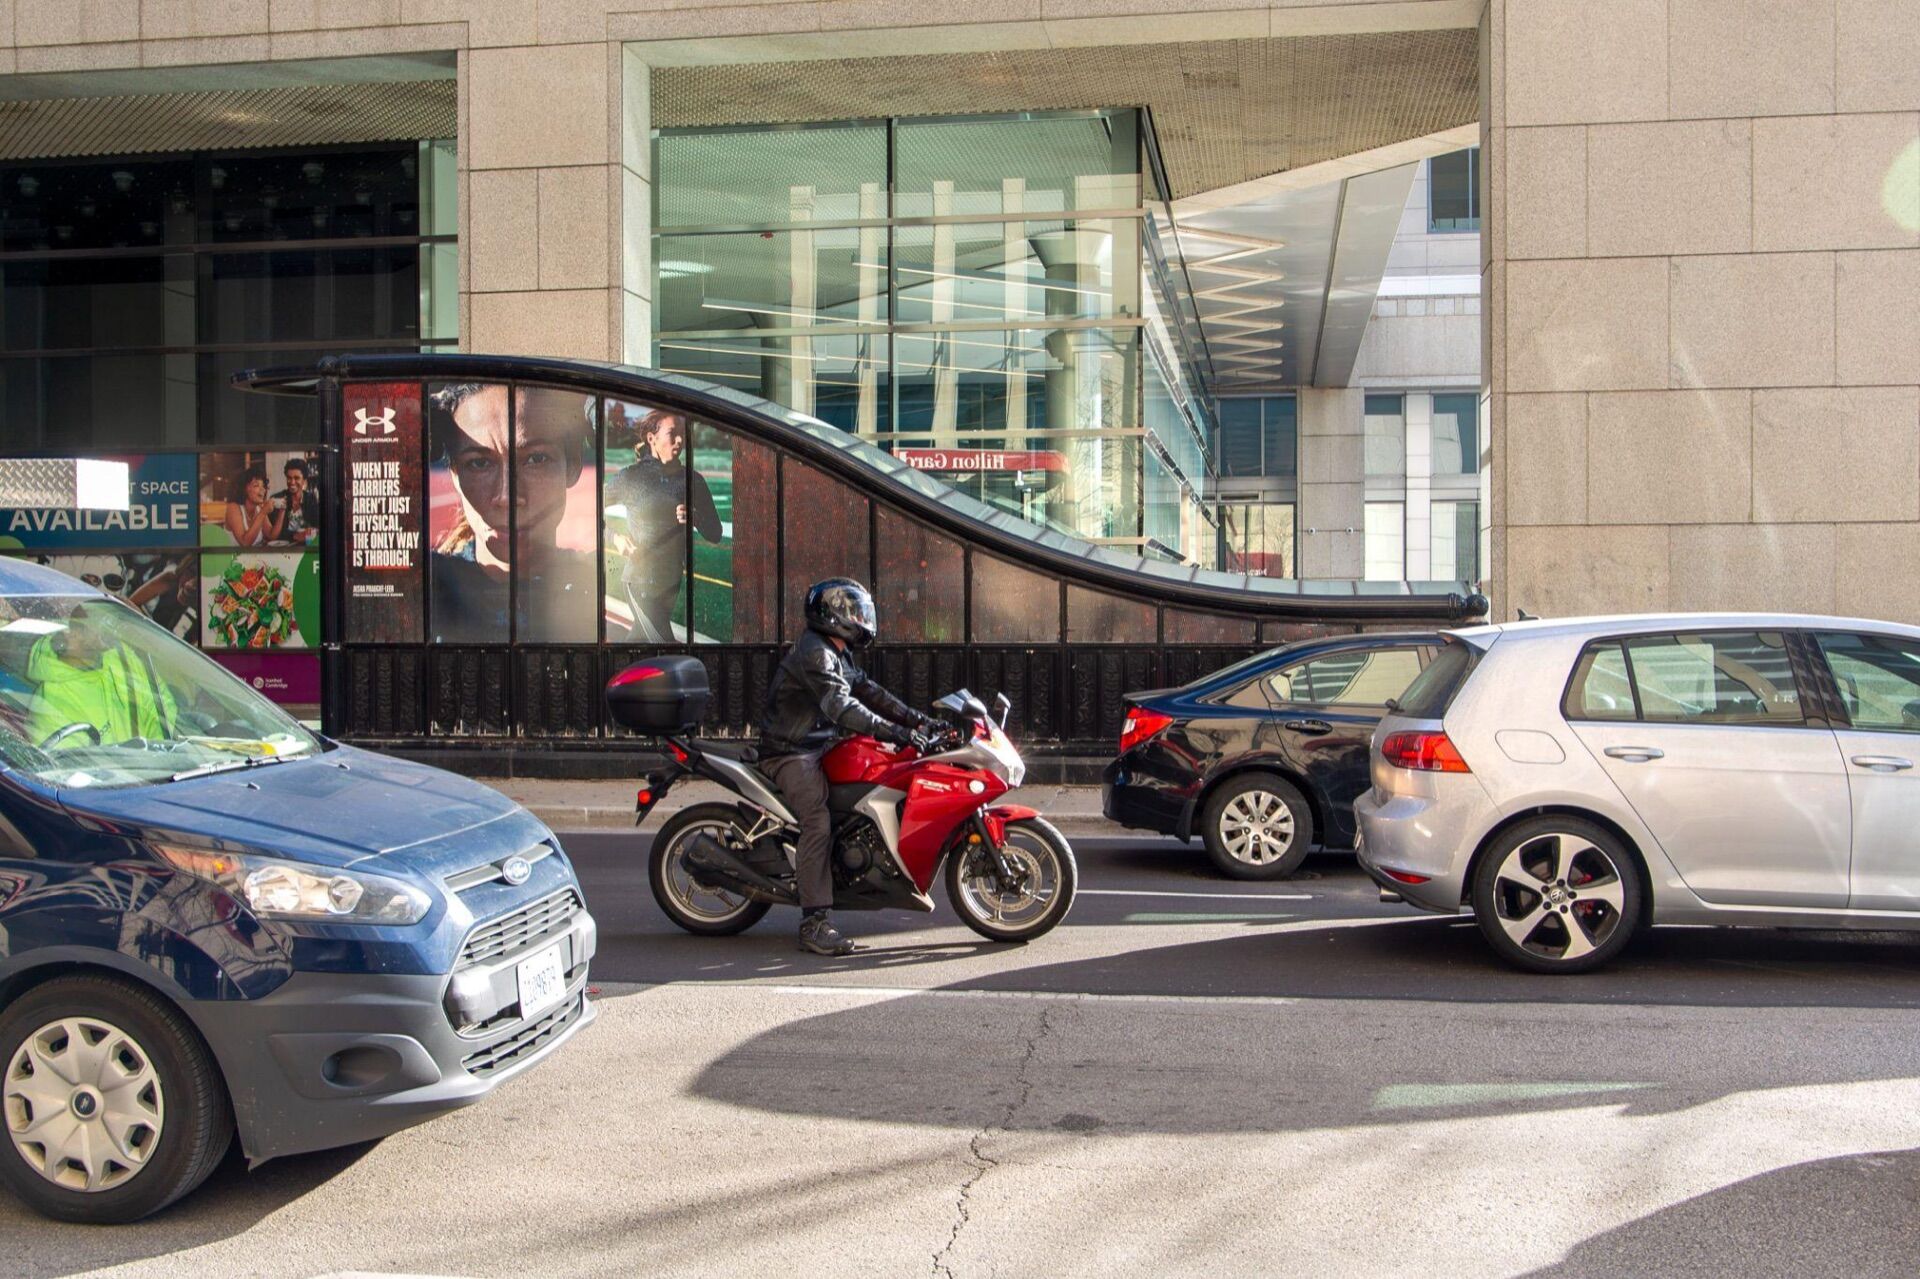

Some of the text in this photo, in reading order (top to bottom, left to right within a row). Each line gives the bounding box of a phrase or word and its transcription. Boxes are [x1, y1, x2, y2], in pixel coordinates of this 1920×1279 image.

[352, 461, 400, 479] WHEN THE
[140, 481, 189, 495] SPACE
[352, 479, 400, 496] BARRIERS
[352, 496, 410, 514] AREN'T JUST
[8, 503, 189, 531] AVAILABLE
[352, 514, 403, 532] PHYSICAL,
[352, 532, 419, 549] THE ONLY WAY
[352, 549, 414, 567] IS THROUGH.
